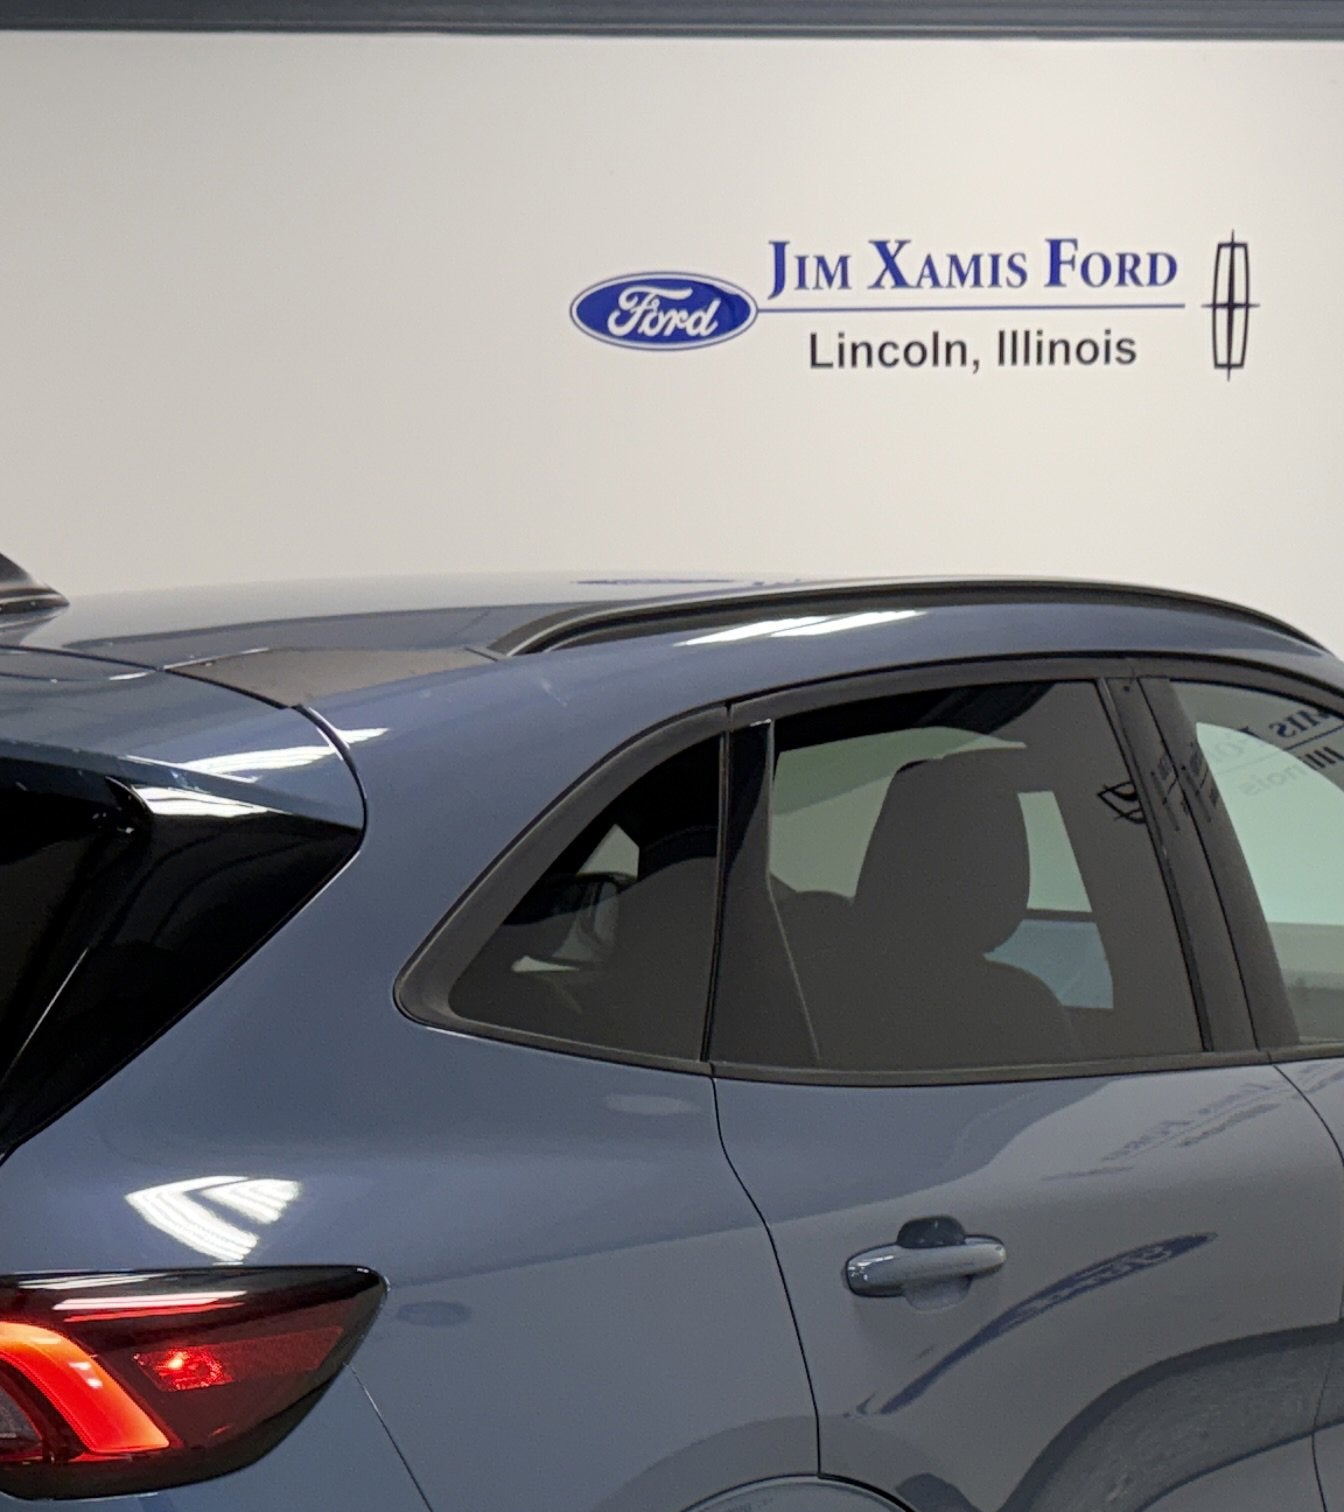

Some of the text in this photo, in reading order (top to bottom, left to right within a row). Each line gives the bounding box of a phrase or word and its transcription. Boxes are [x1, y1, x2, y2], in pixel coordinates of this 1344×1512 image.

[767, 238, 1178, 301] JIM XAMIS FORD
[607, 285, 722, 337] Ford
[809, 328, 1138, 375] Lincoln, Illinois
